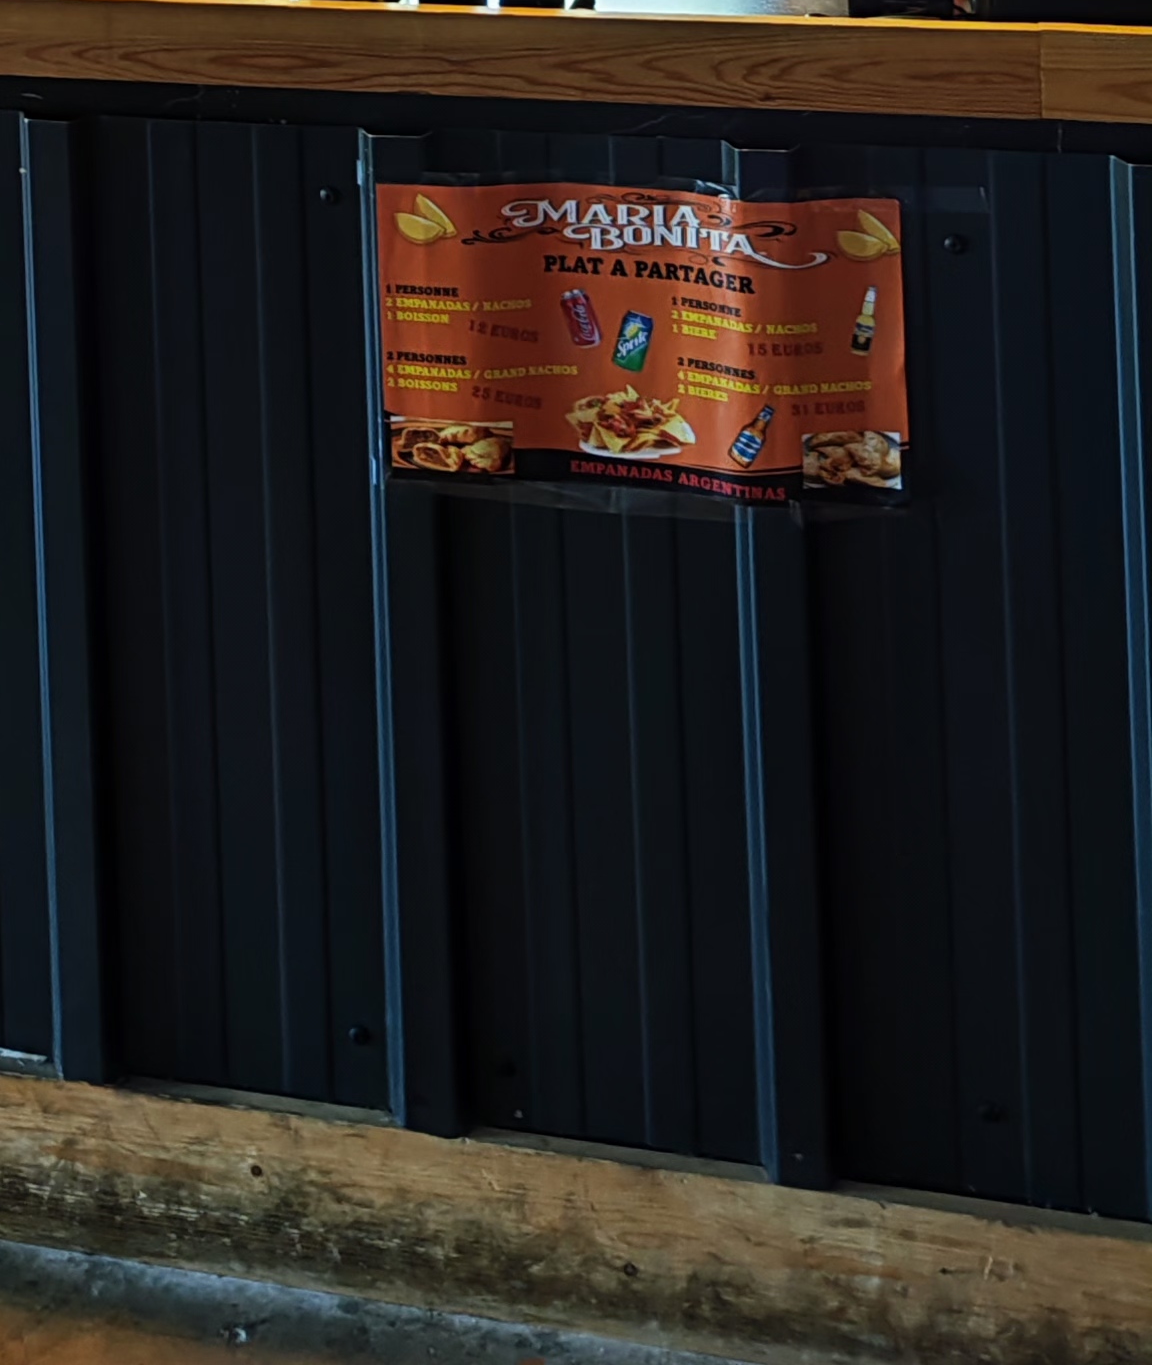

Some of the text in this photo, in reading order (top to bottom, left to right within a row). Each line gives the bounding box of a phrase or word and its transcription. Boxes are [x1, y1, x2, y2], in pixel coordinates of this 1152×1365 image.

[501, 199, 700, 228] MARIA
[562, 222, 830, 269] BONITA
[543, 254, 756, 295] PLAT A PARTAGER
[385, 283, 459, 298] 1 PERSONNE
[385, 297, 394, 308] 2
[396, 298, 471, 312] EMPANADAS
[482, 299, 532, 312] NACHOS
[671, 296, 742, 318] 1 PERSONNE
[386, 312, 449, 324] 1 BOISSON
[681, 311, 753, 334] EMPANADAS
[766, 323, 818, 335] NACHOS
[490, 323, 540, 343] EUROS
[672, 324, 679, 334] 1
[747, 342, 825, 356] 15 EUROS
[386, 351, 467, 366] 2 PERSONNES
[398, 365, 472, 379] EMPANADAS
[483, 367, 527, 379] GRAND
[528, 365, 578, 377] NACHOS
[677, 357, 756, 380] 2 PERSONNES
[387, 378, 459, 392] 2 BOISSONS
[678, 384, 686, 394] 2
[687, 372, 760, 395] EMPANADAS
[773, 384, 818, 395] GRAND
[820, 381, 872, 394] NACHOS
[494, 390, 542, 410] EUROS
[814, 400, 866, 416] EUROS
[569, 460, 787, 501] EMPANADAS ARGENTINAS
